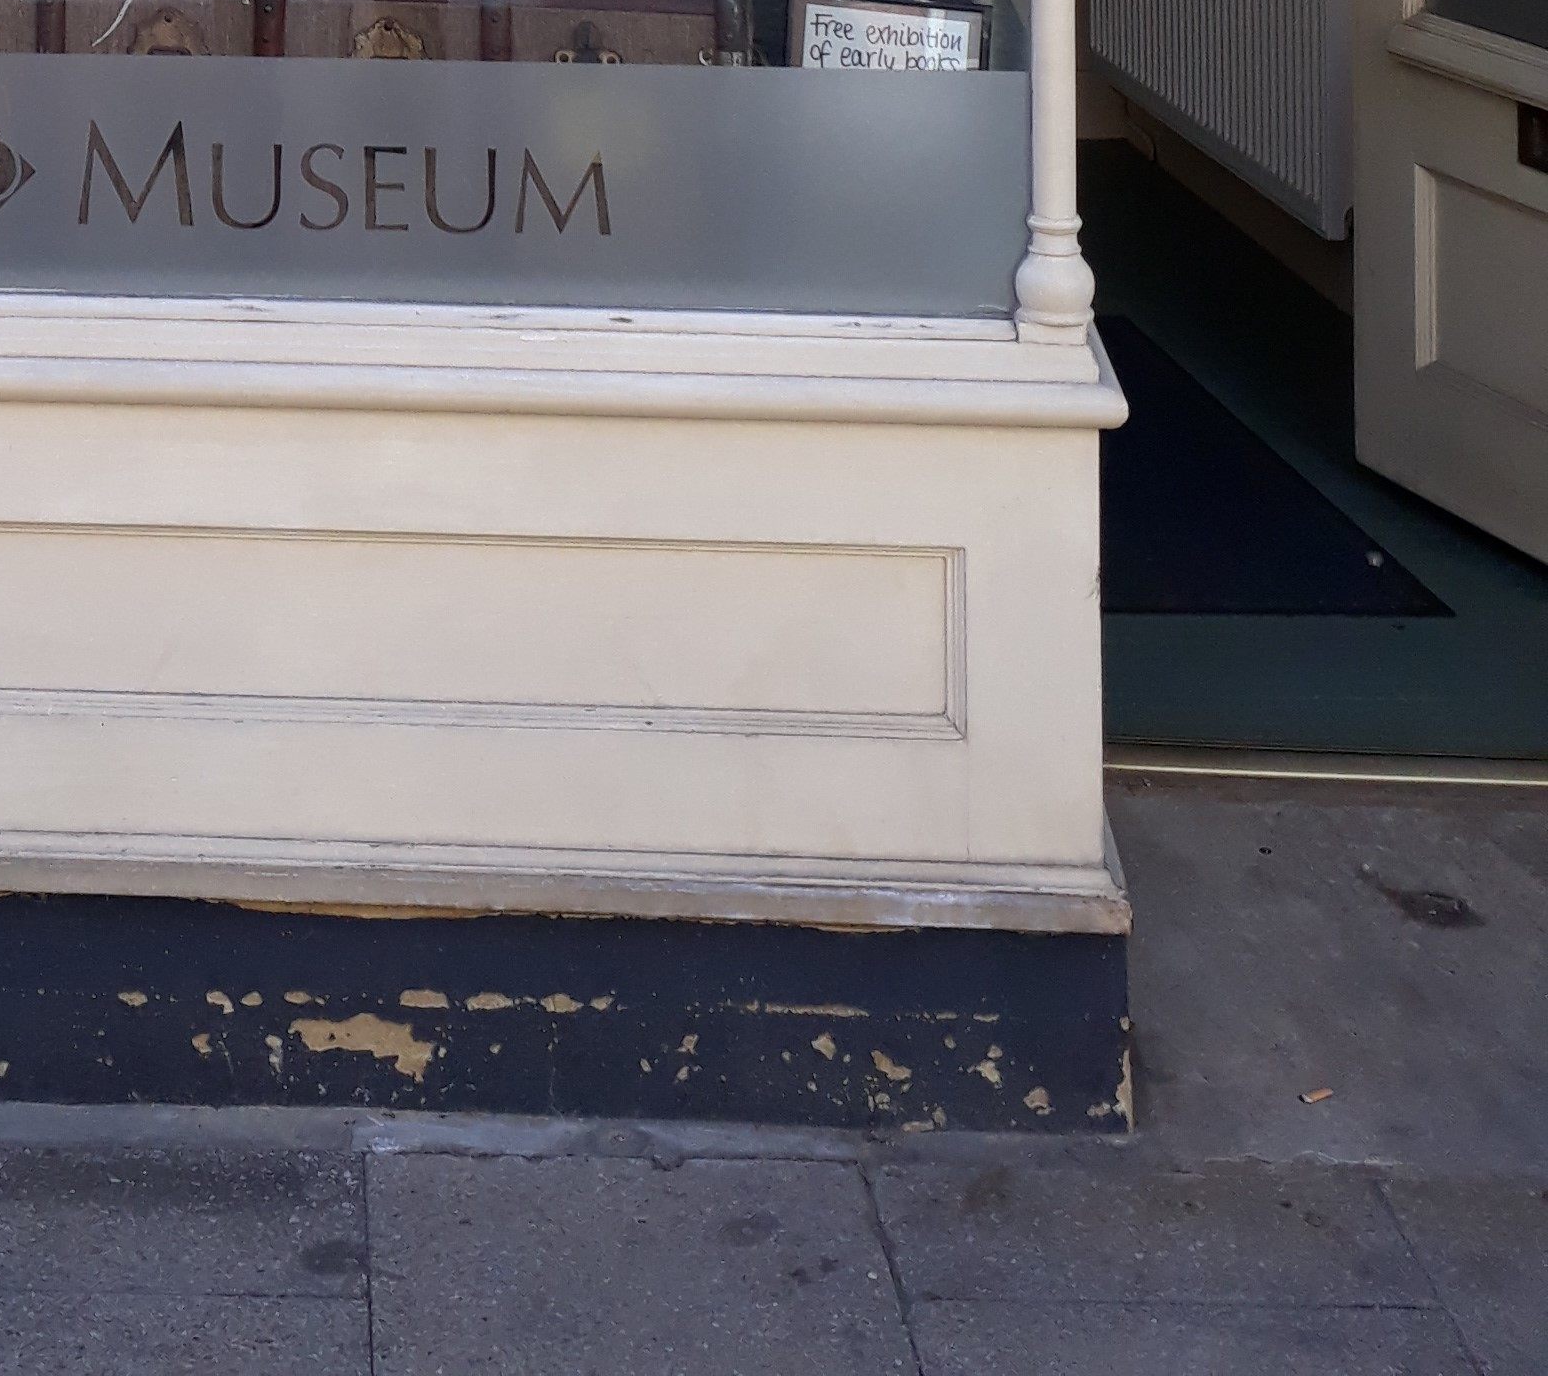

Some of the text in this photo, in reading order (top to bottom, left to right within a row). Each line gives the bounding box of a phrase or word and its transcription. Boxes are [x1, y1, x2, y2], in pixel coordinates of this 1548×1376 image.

[810, 13, 964, 52] Free exhibition
[809, 40, 832, 69] of
[78, 120, 612, 237] MUSEUM
